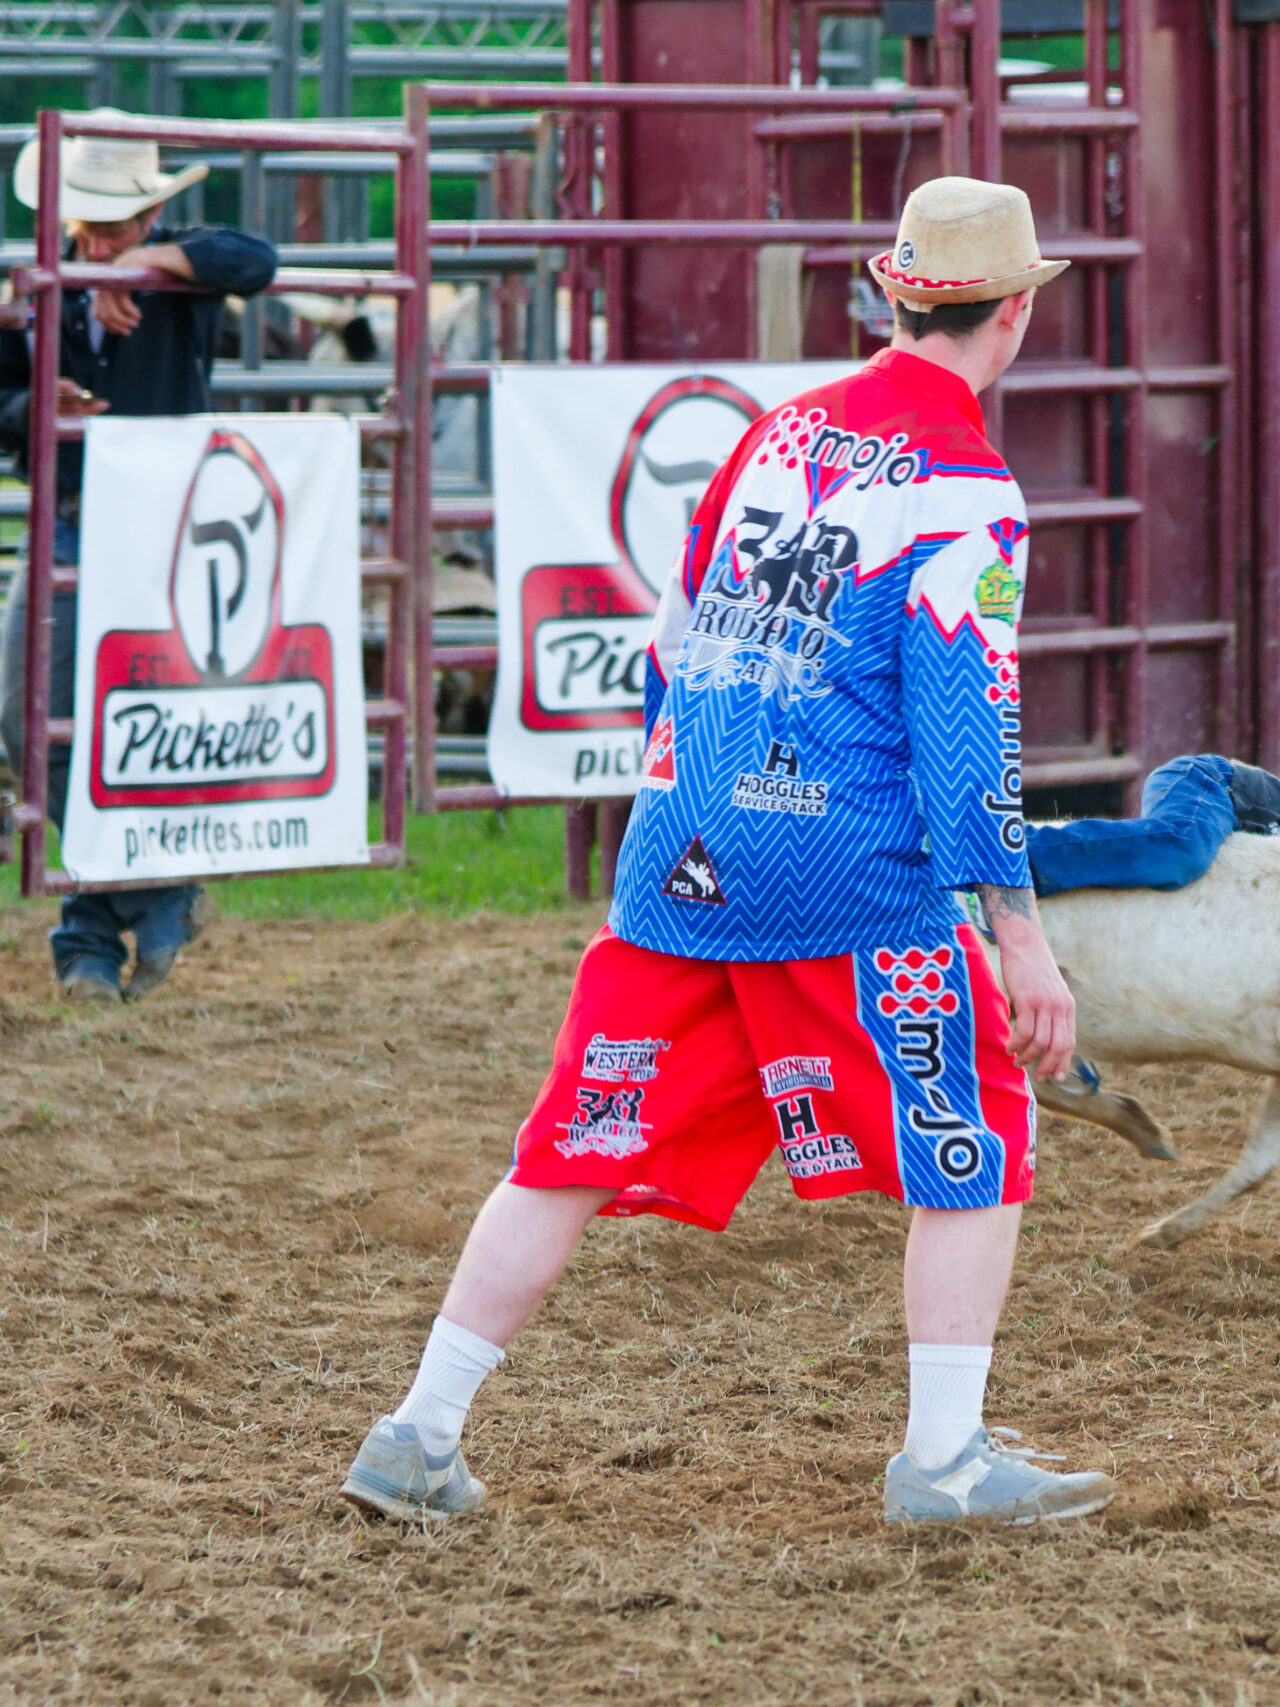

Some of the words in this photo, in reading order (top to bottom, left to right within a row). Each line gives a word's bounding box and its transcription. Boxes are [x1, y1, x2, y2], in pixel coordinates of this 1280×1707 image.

[808, 427, 916, 492] mojo
[113, 702, 315, 774] Pickette's
[737, 776, 827, 801] HOGGLES
[733, 796, 778, 810] SERVICE
[792, 802, 825, 815] TACK
[672, 880, 693, 896] PCA
[585, 1049, 657, 1070] WESTERN
[779, 1137, 856, 1164] GGLES
[826, 1155, 860, 1170] TACK
